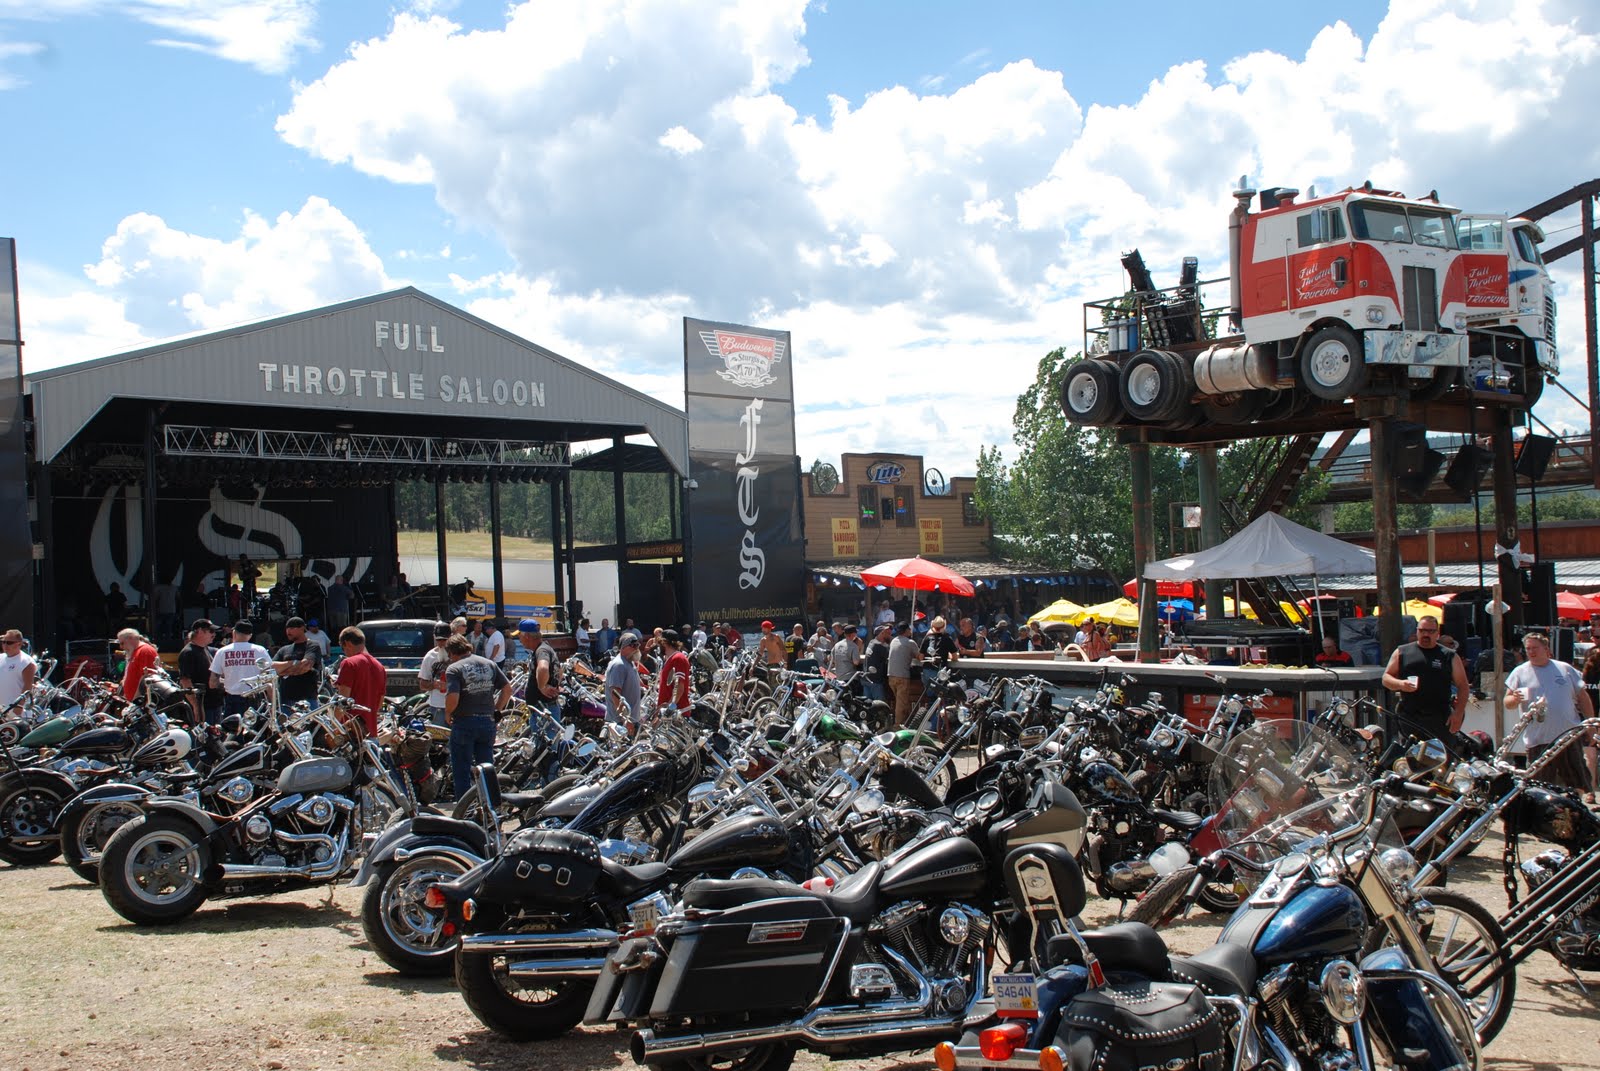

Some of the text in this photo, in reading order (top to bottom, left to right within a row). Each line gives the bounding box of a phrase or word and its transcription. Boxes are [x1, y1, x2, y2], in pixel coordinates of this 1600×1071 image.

[1299, 263, 1318, 279] Full
[1301, 268, 1332, 288] Throttl
[1469, 266, 1490, 278] Full
[1468, 274, 1503, 289] Throttle
[1299, 287, 1339, 300] TRUCKING
[1467, 294, 1509, 305] TRUCKING
[375, 320, 445, 352] FULL
[720, 336, 773, 353] Budweiser
[738, 353, 760, 364] Sturgis
[259, 362, 546, 407] THROTTLE SALOON
[874, 465, 902, 481] Lite
[698, 606, 801, 620] www.fullthrottlesaloon.com
[225, 650, 255, 659] KNOWN
